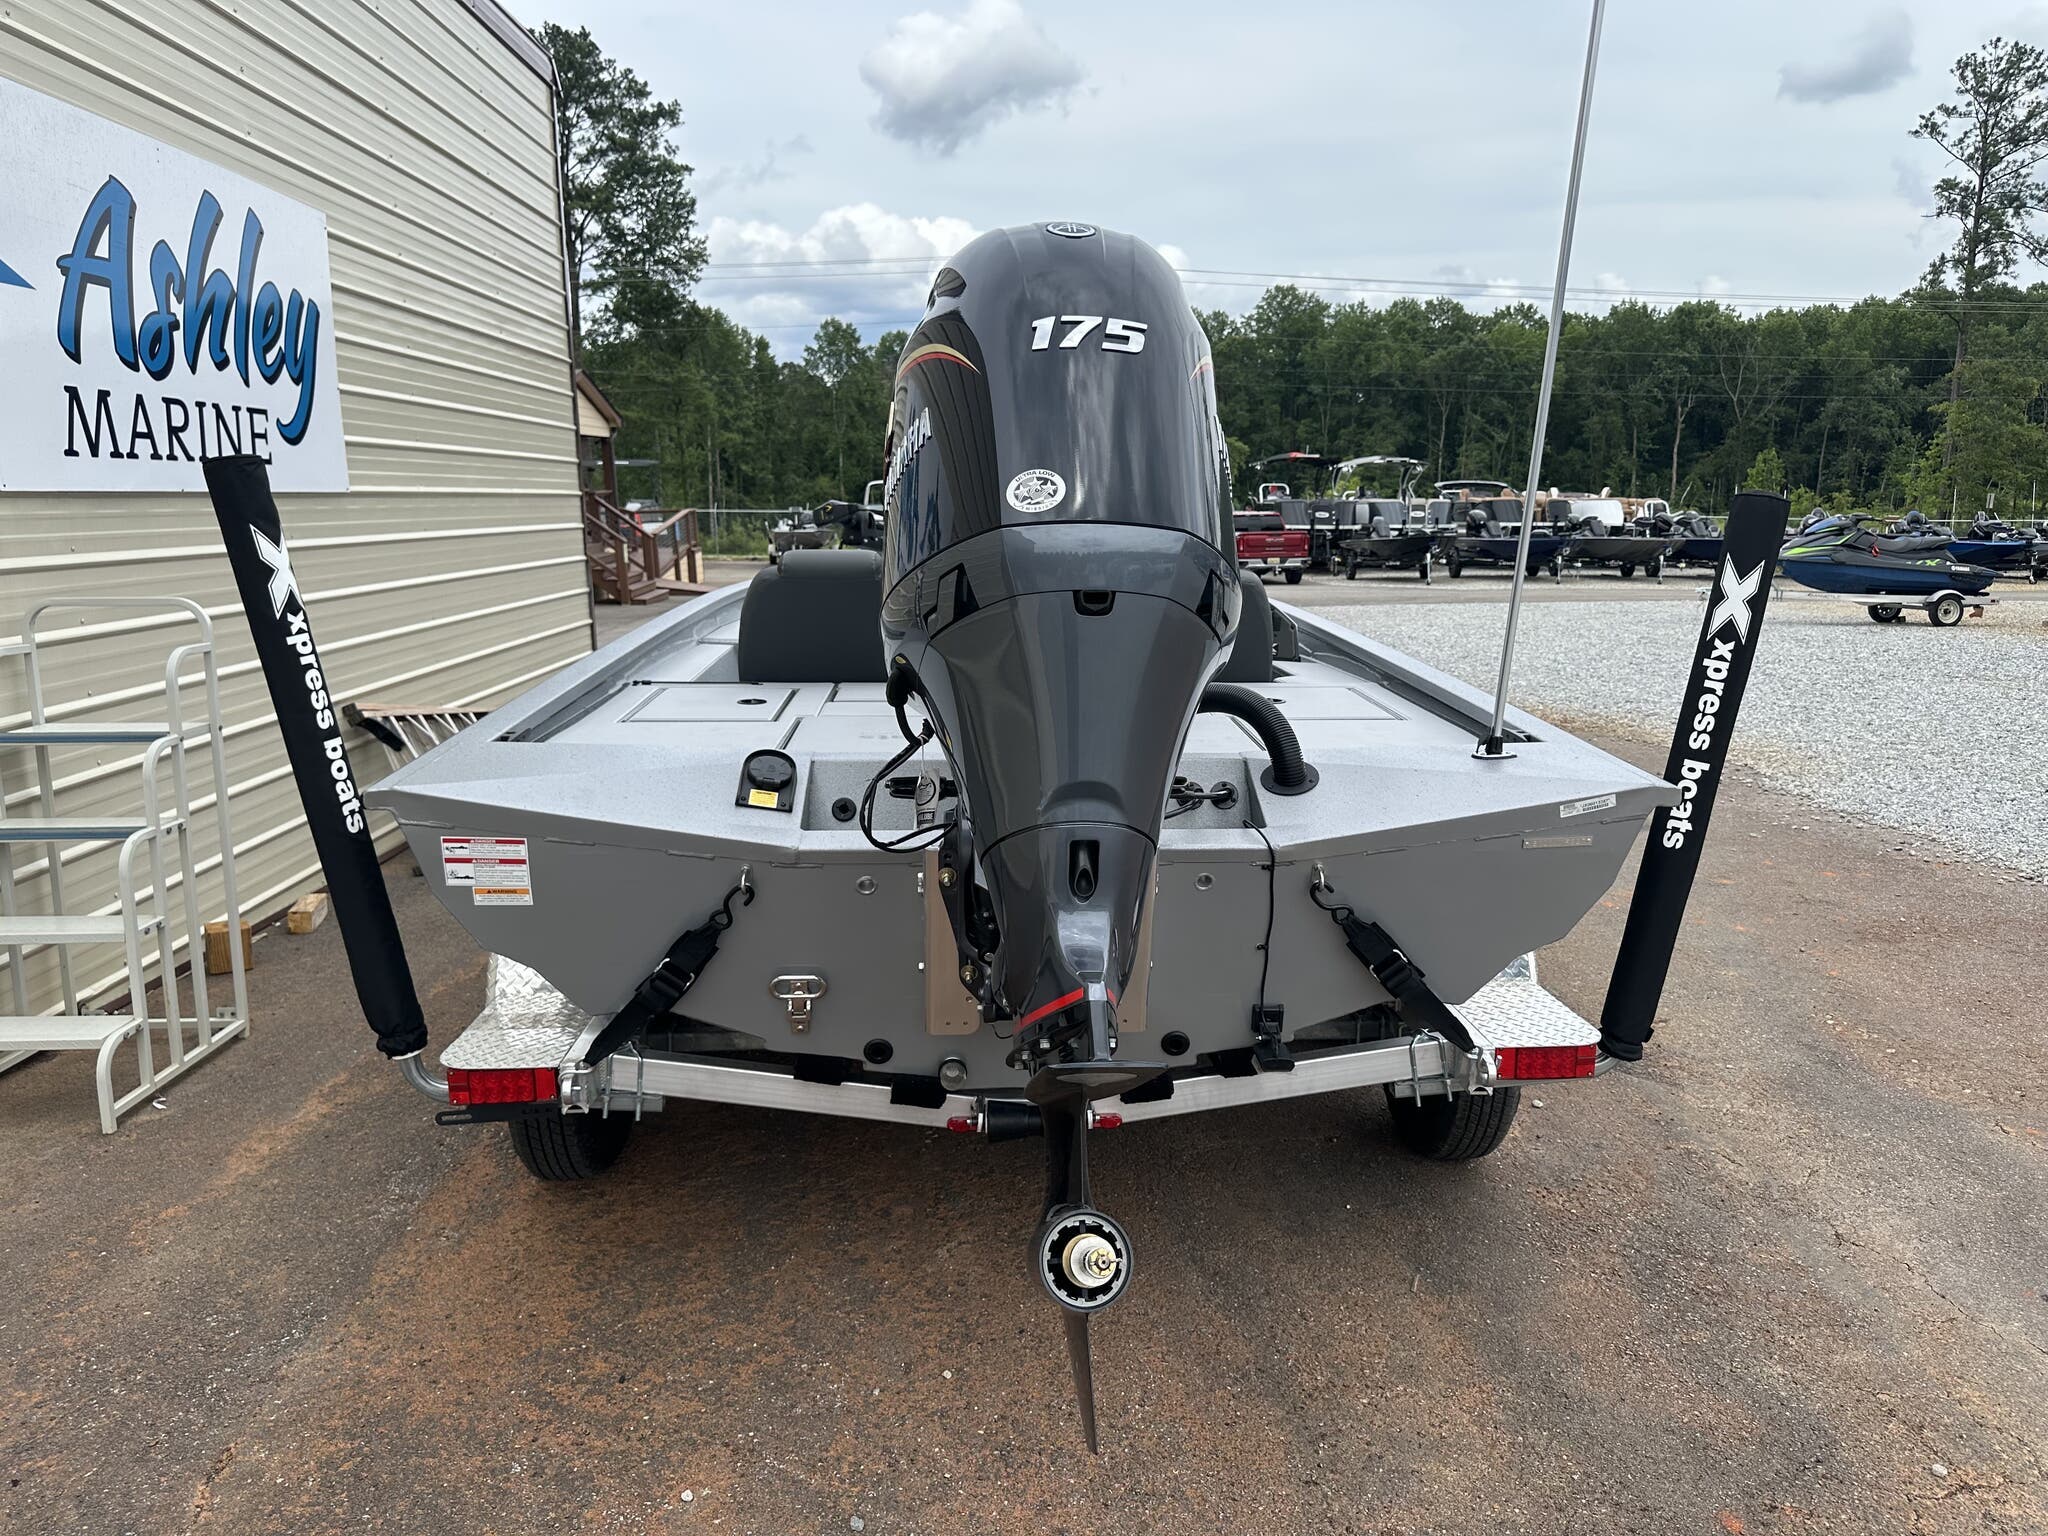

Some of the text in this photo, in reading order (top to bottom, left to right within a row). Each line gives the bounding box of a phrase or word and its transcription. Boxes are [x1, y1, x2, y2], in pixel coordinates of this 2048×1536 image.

[56, 174, 320, 446] Ashley
[1031, 315, 1148, 354] 175
[63, 385, 273, 465] MARINE
[1038, 470, 1056, 478] LOW
[286, 610, 364, 835] xpress boats
[1662, 637, 1736, 850] xpress boats
